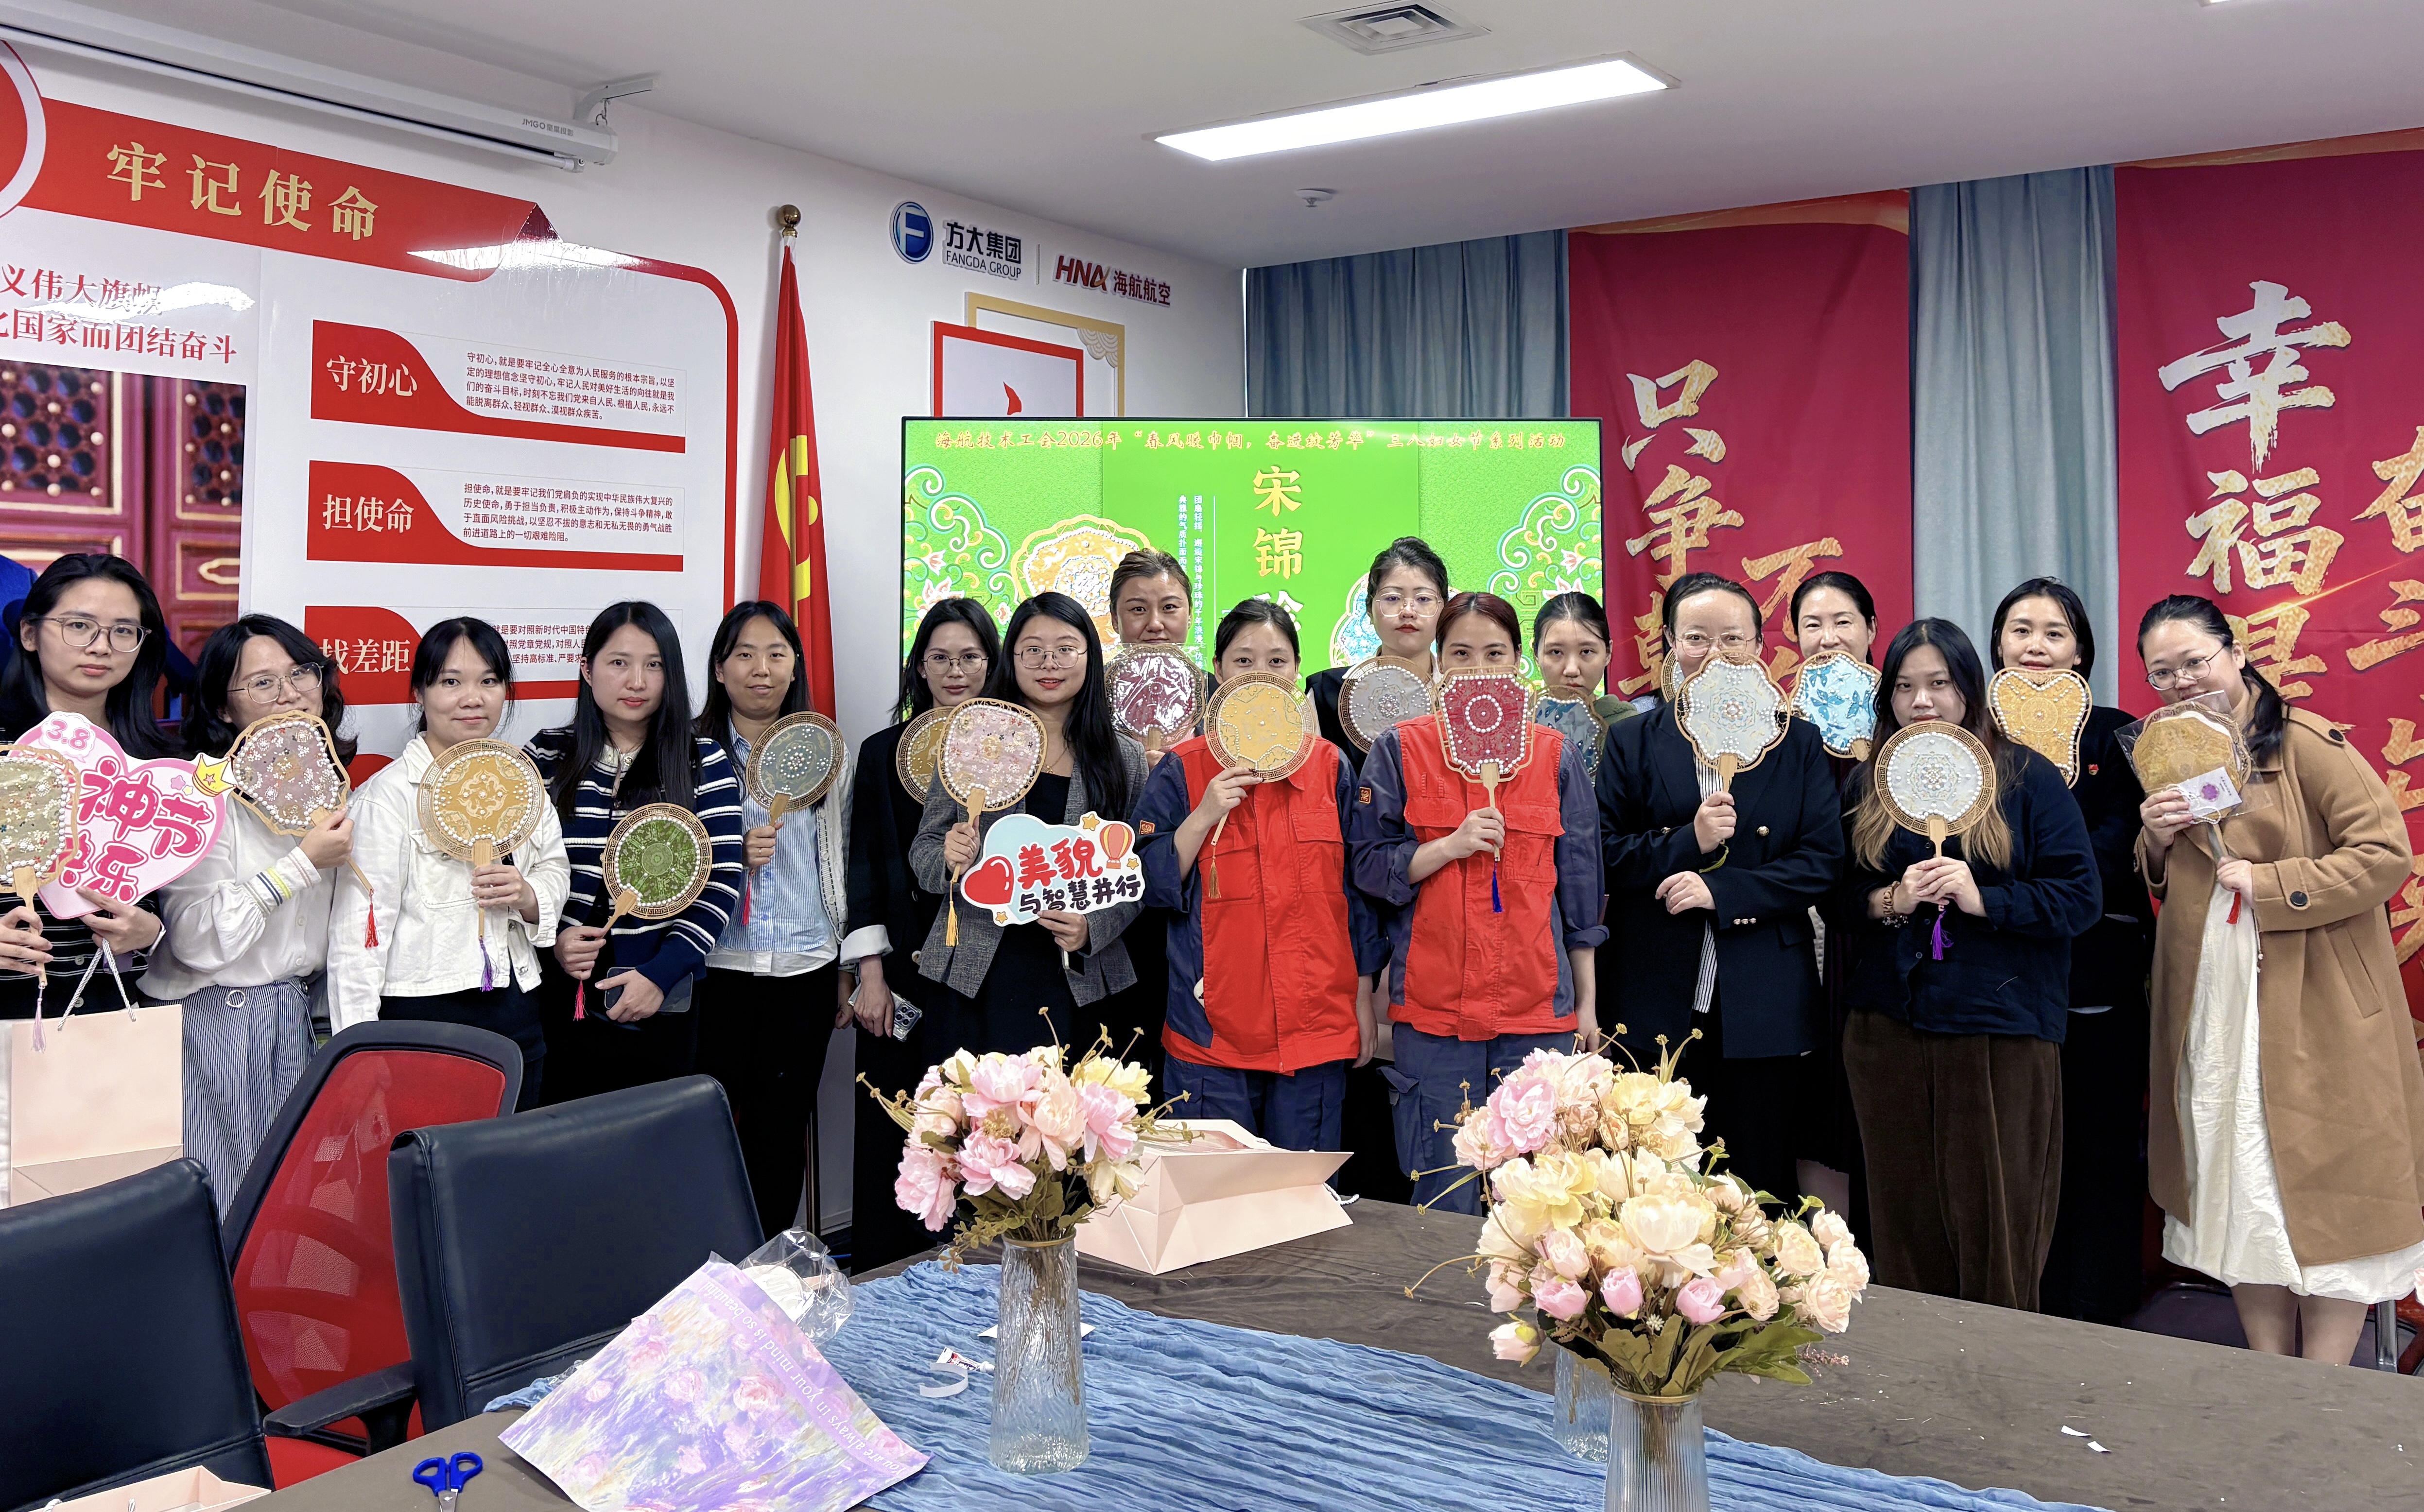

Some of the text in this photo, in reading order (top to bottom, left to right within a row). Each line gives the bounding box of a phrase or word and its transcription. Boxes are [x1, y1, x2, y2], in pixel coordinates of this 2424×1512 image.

[522, 119, 545, 129] JMGO
[106, 141, 379, 241] 牢记使命
[946, 222, 1021, 264] 方大集团
[946, 250, 1022, 278] FANGDA GROUP
[1056, 255, 1170, 305] HNA 海航航空
[326, 355, 417, 397] 守初心
[322, 493, 414, 533] 担使命
[318, 638, 411, 674] 找差距
[45, 719, 91, 750] 3.8
[1017, 837, 1103, 890] 美貌
[1019, 874, 1141, 915] 与智慧并行
[698, 1281, 906, 1475] You are always in your mind is so beautiful
